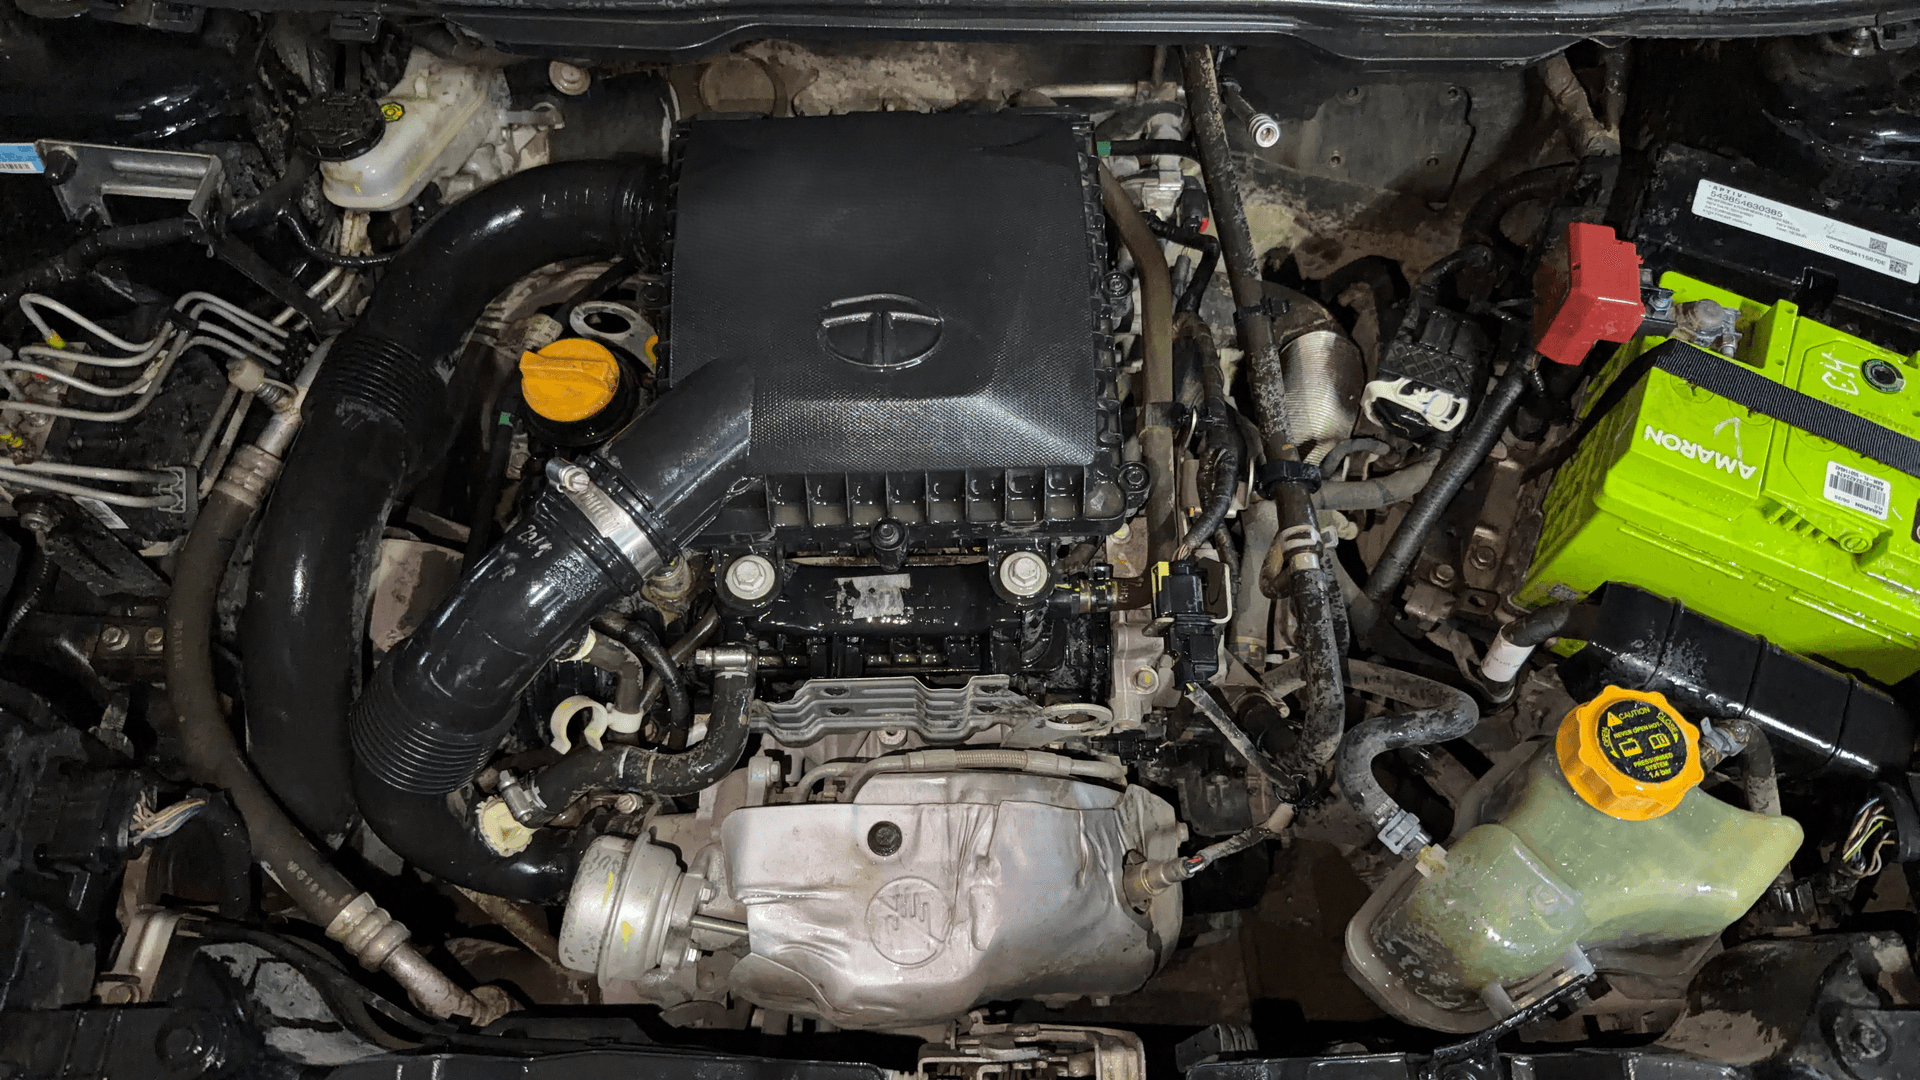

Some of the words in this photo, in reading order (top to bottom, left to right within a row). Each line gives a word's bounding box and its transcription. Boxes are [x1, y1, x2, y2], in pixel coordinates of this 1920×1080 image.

[1712, 185, 1742, 198] APTIV
[1710, 190, 1783, 217] 543854630385
[1643, 424, 1757, 480] AMARON
[1854, 502, 1882, 515] AMARON
[1619, 707, 1650, 720] CAUTION
[1614, 730, 1633, 739] NEVER
[1634, 725, 1649, 733] OPEN
[1649, 722, 1660, 730] HOT
[1657, 712, 1678, 733] CLOSE
[1602, 727, 1610, 747] OPEN
[1633, 752, 1673, 768] PRESSURISED
[1645, 760, 1669, 772] SYSTEM
[1648, 771, 1659, 779] 1.4
[1660, 768, 1672, 776] bar
